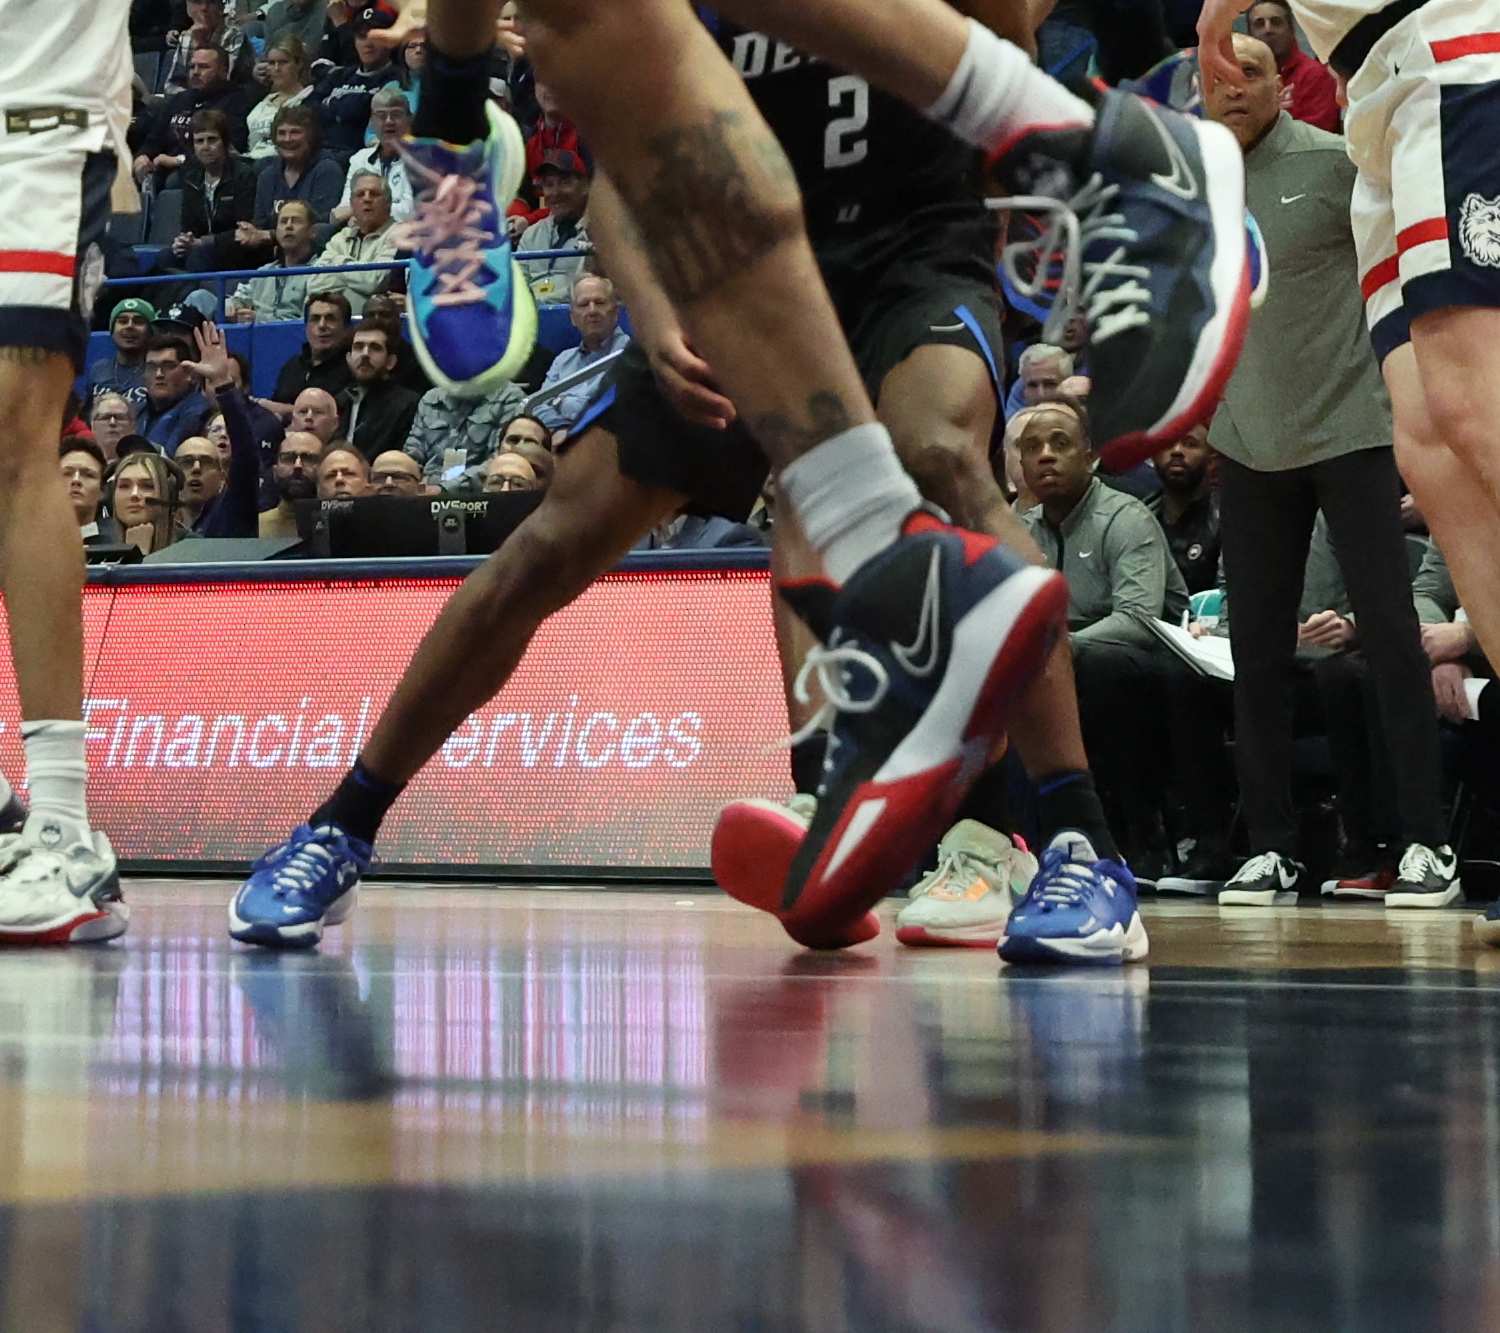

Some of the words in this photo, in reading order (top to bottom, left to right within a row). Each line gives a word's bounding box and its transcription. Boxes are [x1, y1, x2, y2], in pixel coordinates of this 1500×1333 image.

[823, 73, 869, 170] 2
[430, 500, 490, 515] DVSPORT
[83, 695, 371, 769] Financial
[440, 694, 702, 769] ervices
